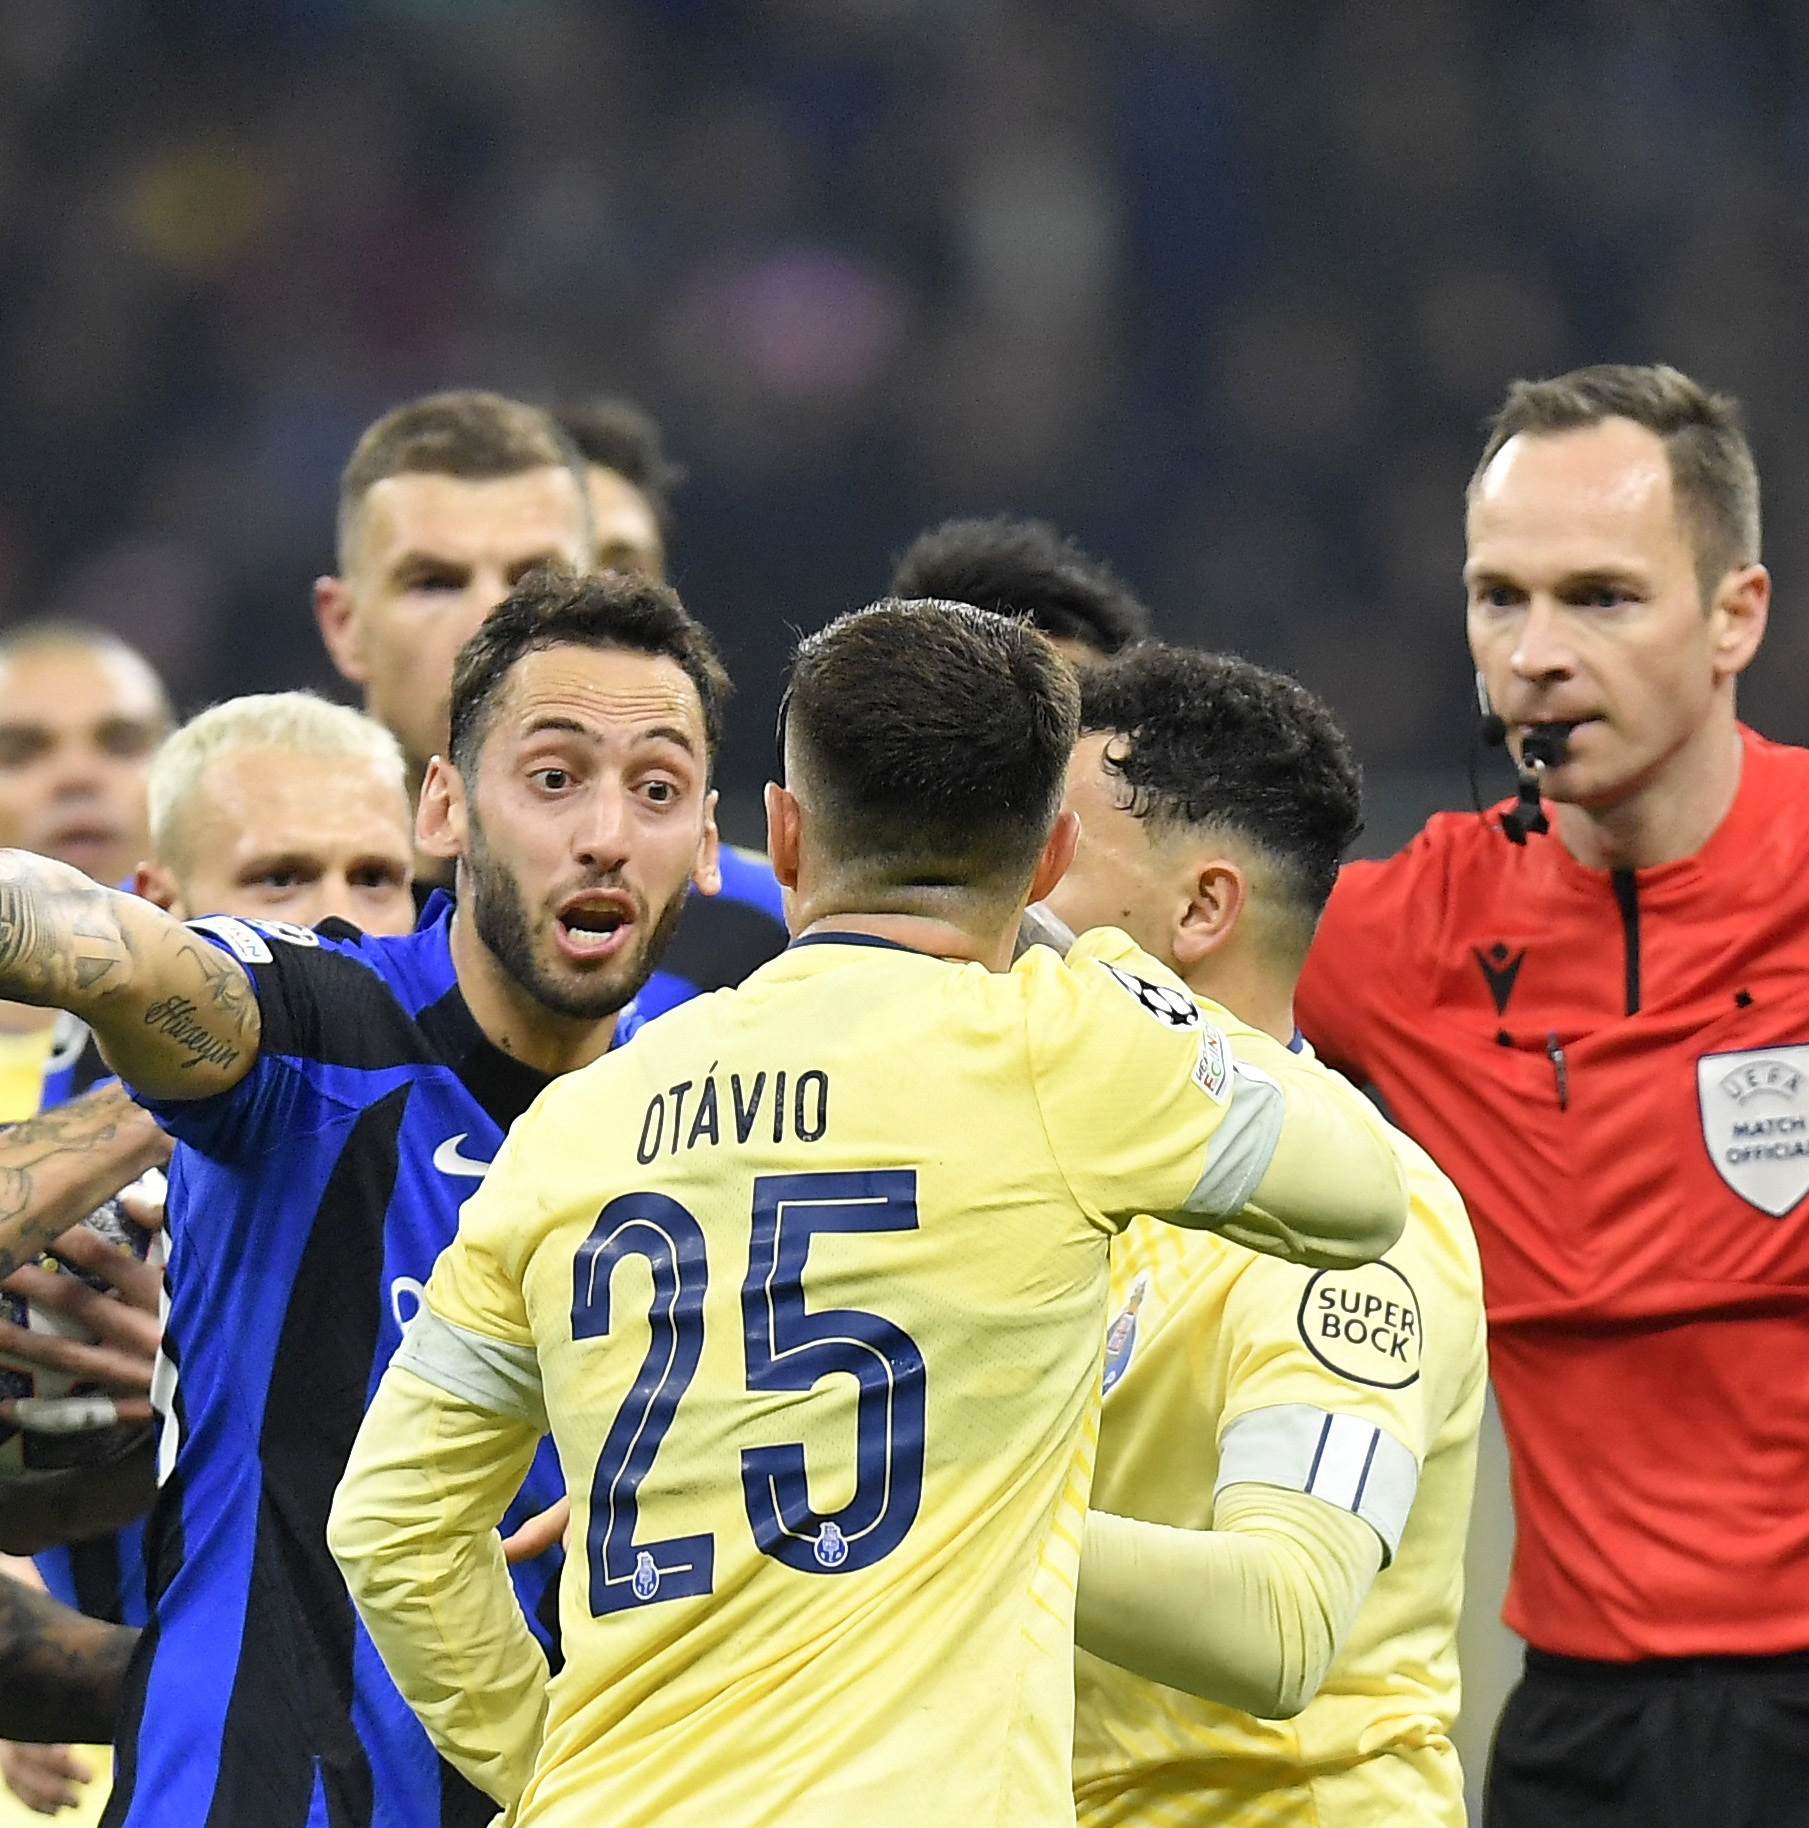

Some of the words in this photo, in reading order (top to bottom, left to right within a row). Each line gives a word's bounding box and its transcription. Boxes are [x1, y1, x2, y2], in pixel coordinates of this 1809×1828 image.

[637, 1061, 829, 1166] OTÁVIO
[1733, 1115, 1806, 1137] MATCH
[1318, 1286, 1415, 1337] SUPER
[1321, 1313, 1409, 1363] BOCK
[572, 1169, 928, 1618] 25
